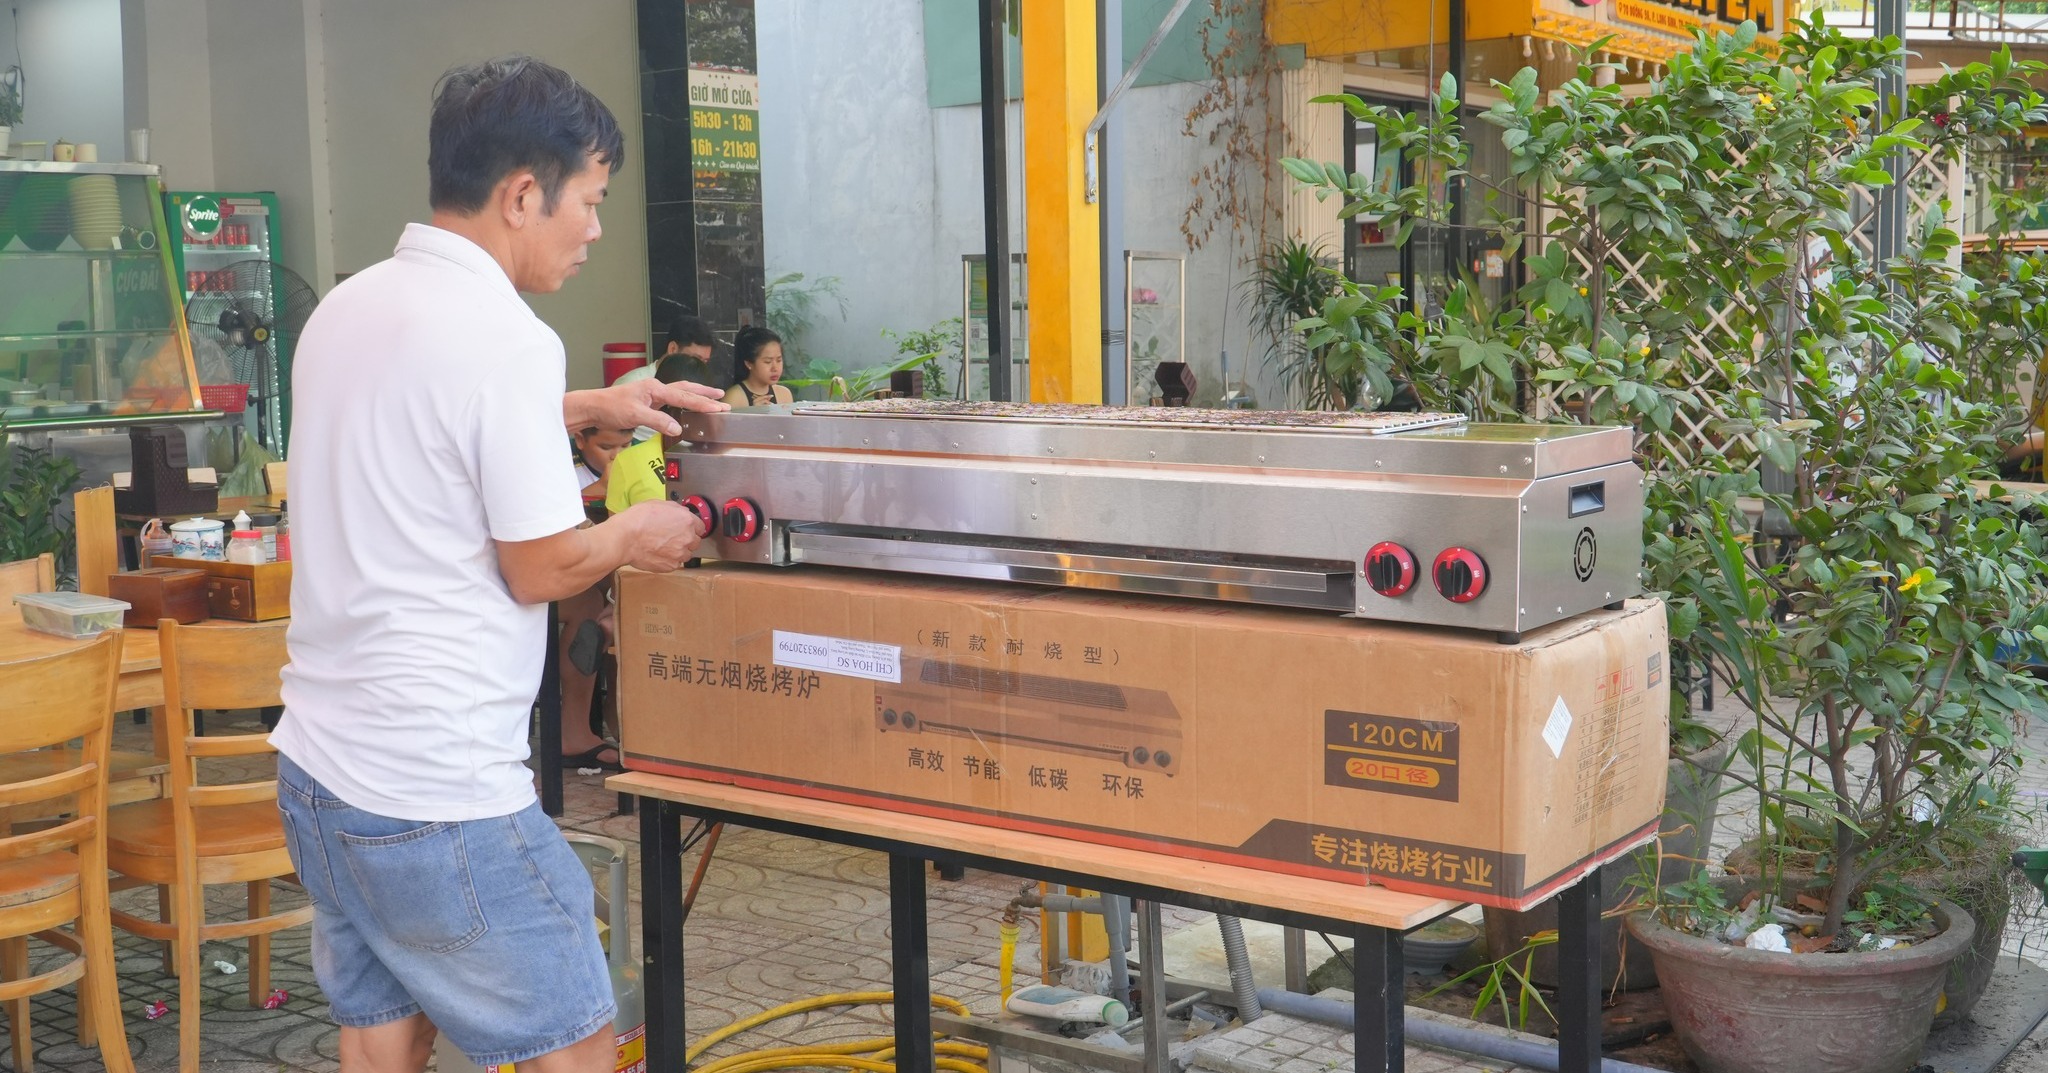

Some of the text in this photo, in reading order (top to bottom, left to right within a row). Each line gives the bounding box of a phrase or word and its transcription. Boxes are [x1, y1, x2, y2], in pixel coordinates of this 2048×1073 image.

[691, 82, 752, 106] GIỜ MỞ CỬA
[693, 110, 721, 129] 5h30
[732, 113, 752, 131] 13h
[692, 138, 712, 156] 16h
[723, 140, 756, 158] 21h30
[189, 208, 219, 221] Sprite
[779, 641, 828, 657] 0983320799
[647, 651, 821, 699] 高端无烟烧烤炉
[837, 656, 893, 674] CHỊ HOA SG
[1348, 721, 1444, 753] 120CM
[908, 747, 1145, 799] 高效 节能 低碳 环保
[1351, 761, 1430, 785] 20口径
[1310, 833, 1494, 888] 专注烧烤行业
